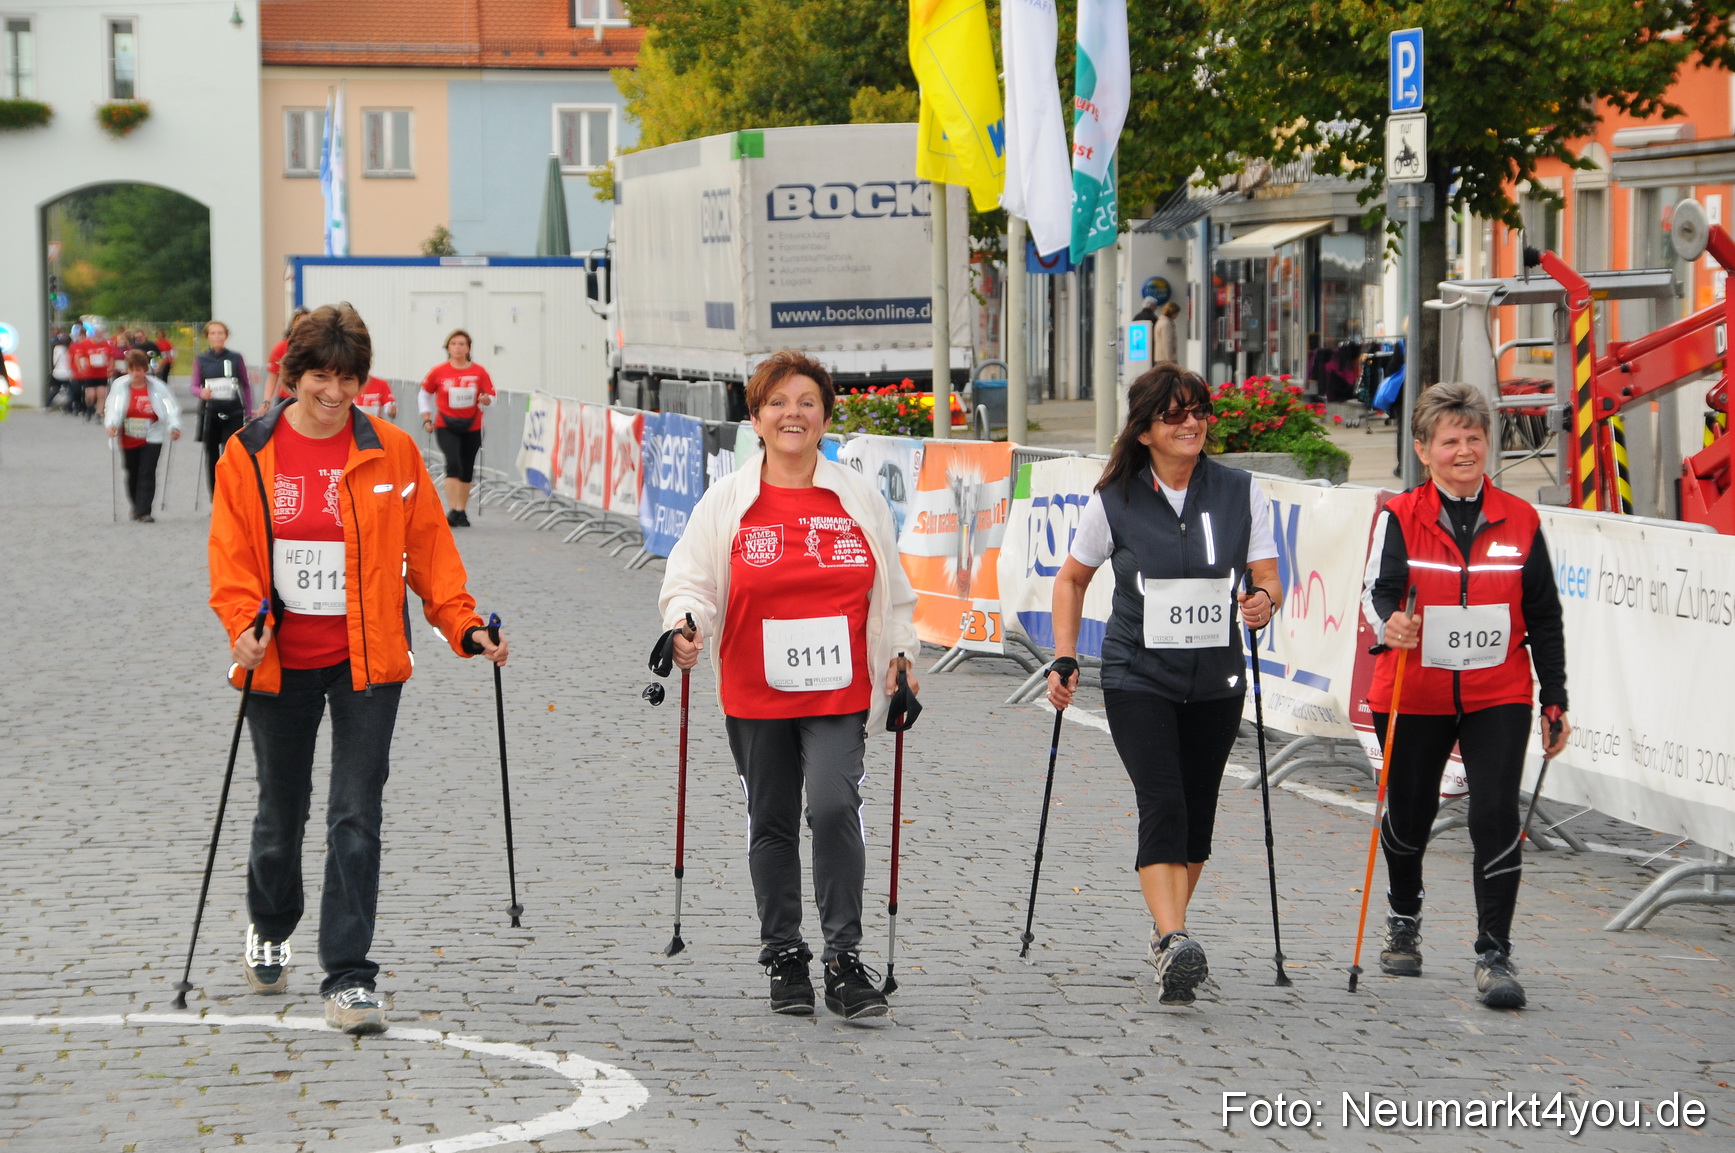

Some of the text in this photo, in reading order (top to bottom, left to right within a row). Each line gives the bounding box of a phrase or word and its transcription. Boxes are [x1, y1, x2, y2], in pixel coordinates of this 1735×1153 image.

[1398, 41, 1416, 100] P
[1400, 123, 1413, 135] nur
[766, 181, 932, 221] BOCK
[701, 188, 731, 243] BOCK
[779, 243, 828, 251] Formenbau
[777, 301, 932, 323] www.bockonline.d
[798, 516, 810, 525] 11.
[810, 523, 851, 532] STADTLAUF
[745, 530, 777, 541] IMMER
[745, 537, 779, 547] WIEDER
[747, 543, 777, 553] NEU
[285, 549, 322, 566] HEDI
[747, 552, 777, 560] MARKT
[1597, 554, 1644, 610] haben
[1650, 564, 1669, 615] ein
[1675, 567, 1735, 627] Zuhaus
[1169, 604, 1222, 625] 8103
[1448, 630, 1502, 649] 8102
[786, 644, 841, 668] 8111
[813, 675, 843, 684] PFLEIDERER
